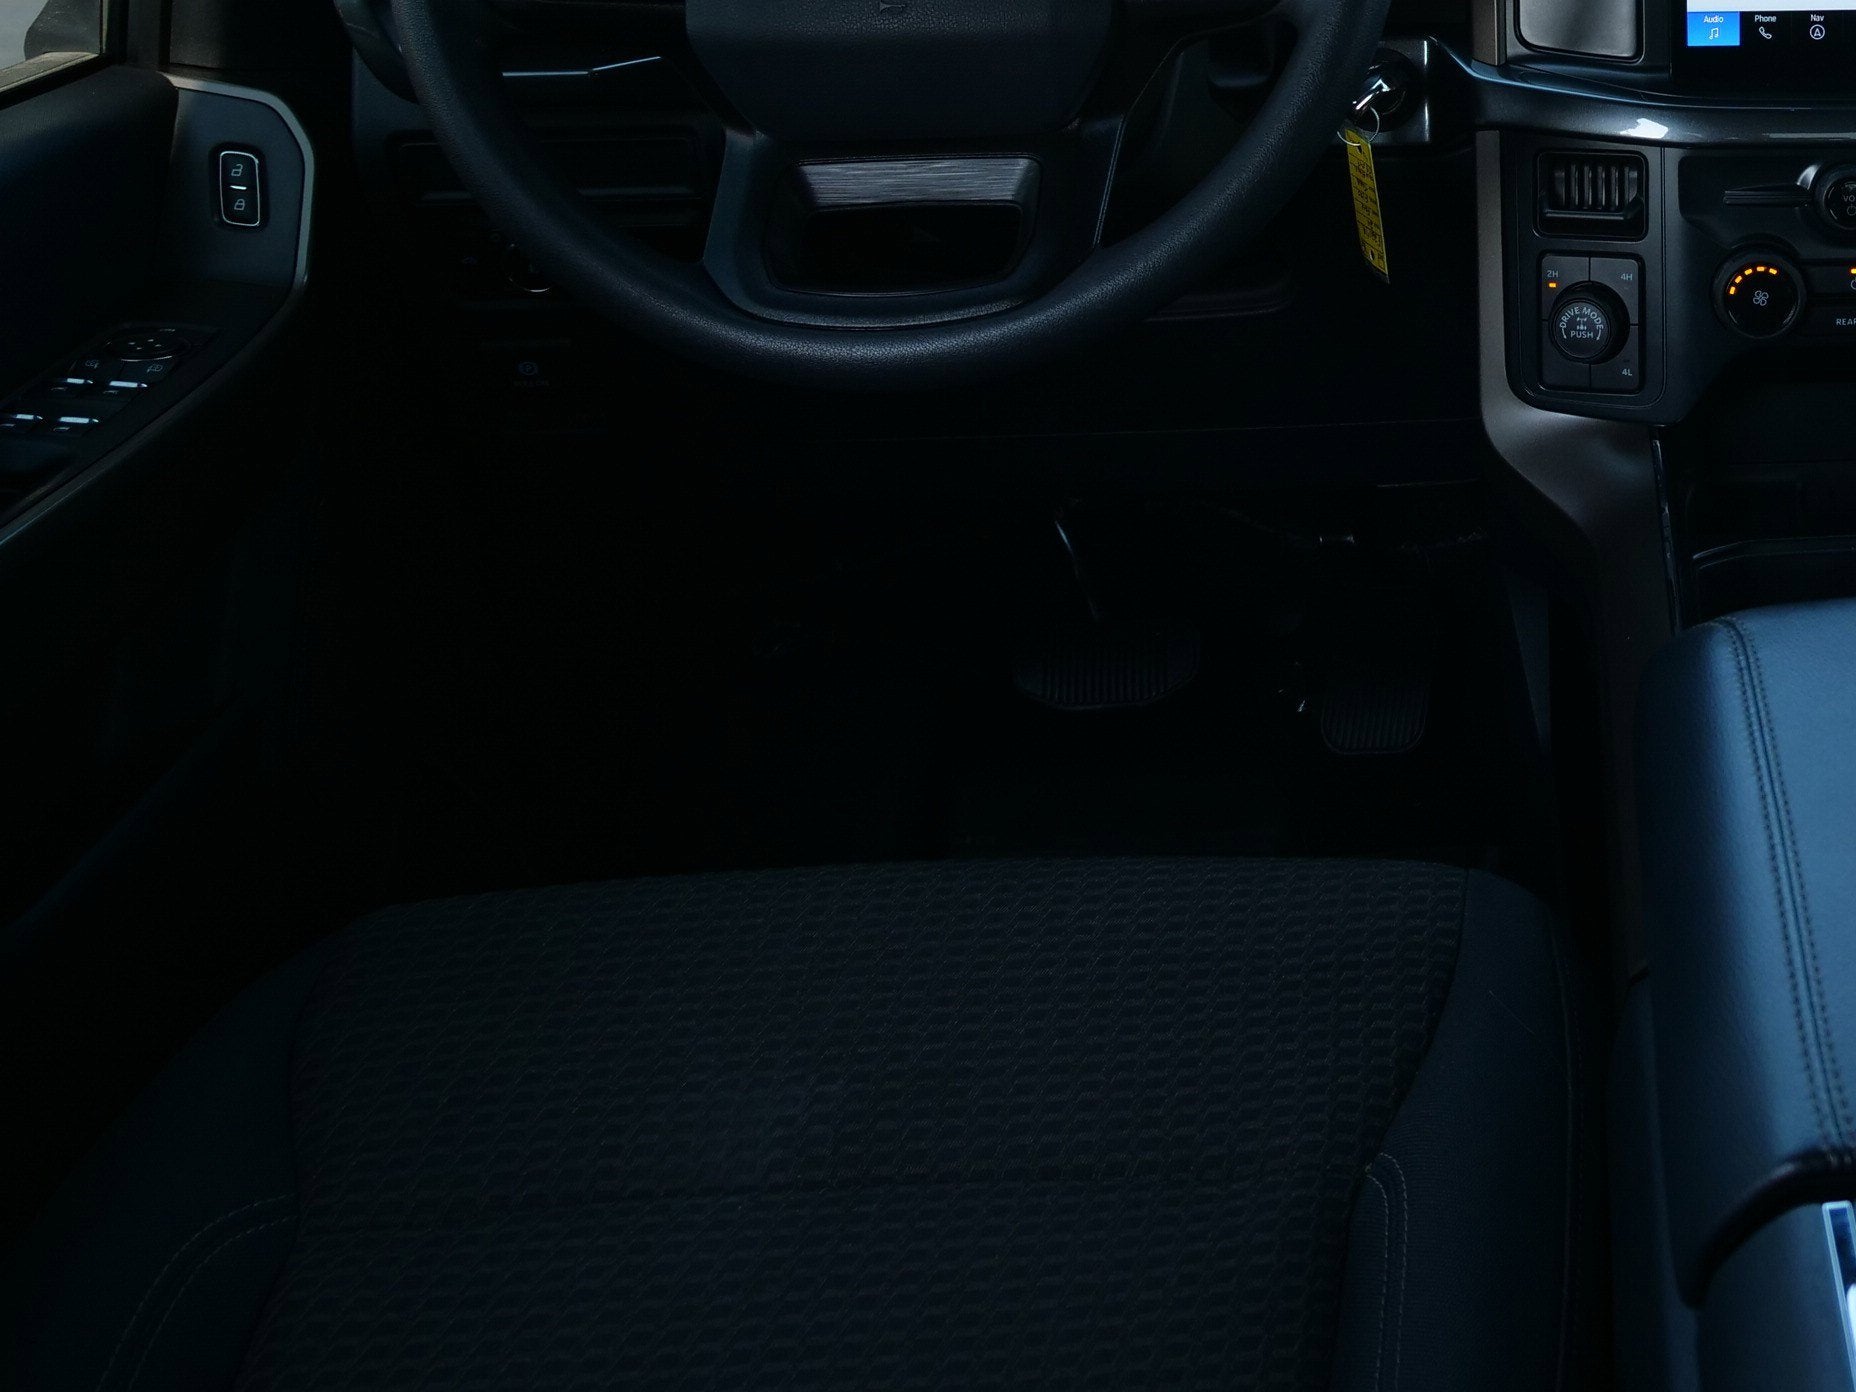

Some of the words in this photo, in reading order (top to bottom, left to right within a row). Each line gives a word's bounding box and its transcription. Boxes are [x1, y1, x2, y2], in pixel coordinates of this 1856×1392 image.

[1703, 15, 1723, 23] Audio
[1754, 14, 1777, 22] Phone
[1810, 14, 1824, 22] Nav
[1546, 269, 1559, 279] 2H
[1620, 272, 1633, 282] 4H
[1558, 306, 1581, 330] DRIVE
[1581, 305, 1605, 330] MODE
[1570, 330, 1594, 340] PUSH
[1621, 367, 1633, 377] 4L
